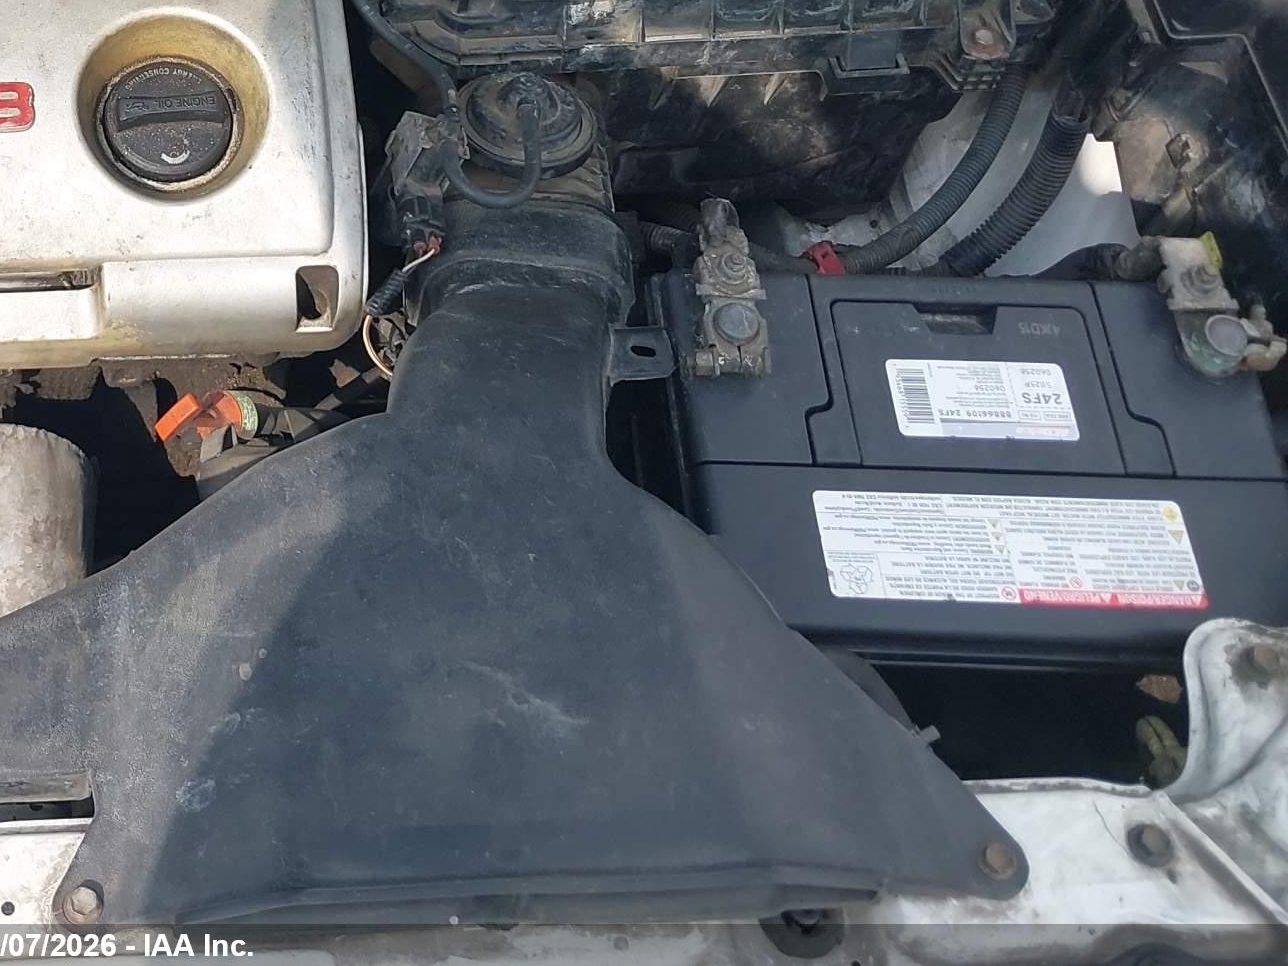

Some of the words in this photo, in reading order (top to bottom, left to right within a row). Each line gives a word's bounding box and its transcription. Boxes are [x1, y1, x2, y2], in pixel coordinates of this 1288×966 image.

[152, 99, 172, 110] OIL
[174, 95, 216, 106] ENGINE
[1021, 392, 1062, 405] 24FS
[938, 408, 961, 417] 24FS
